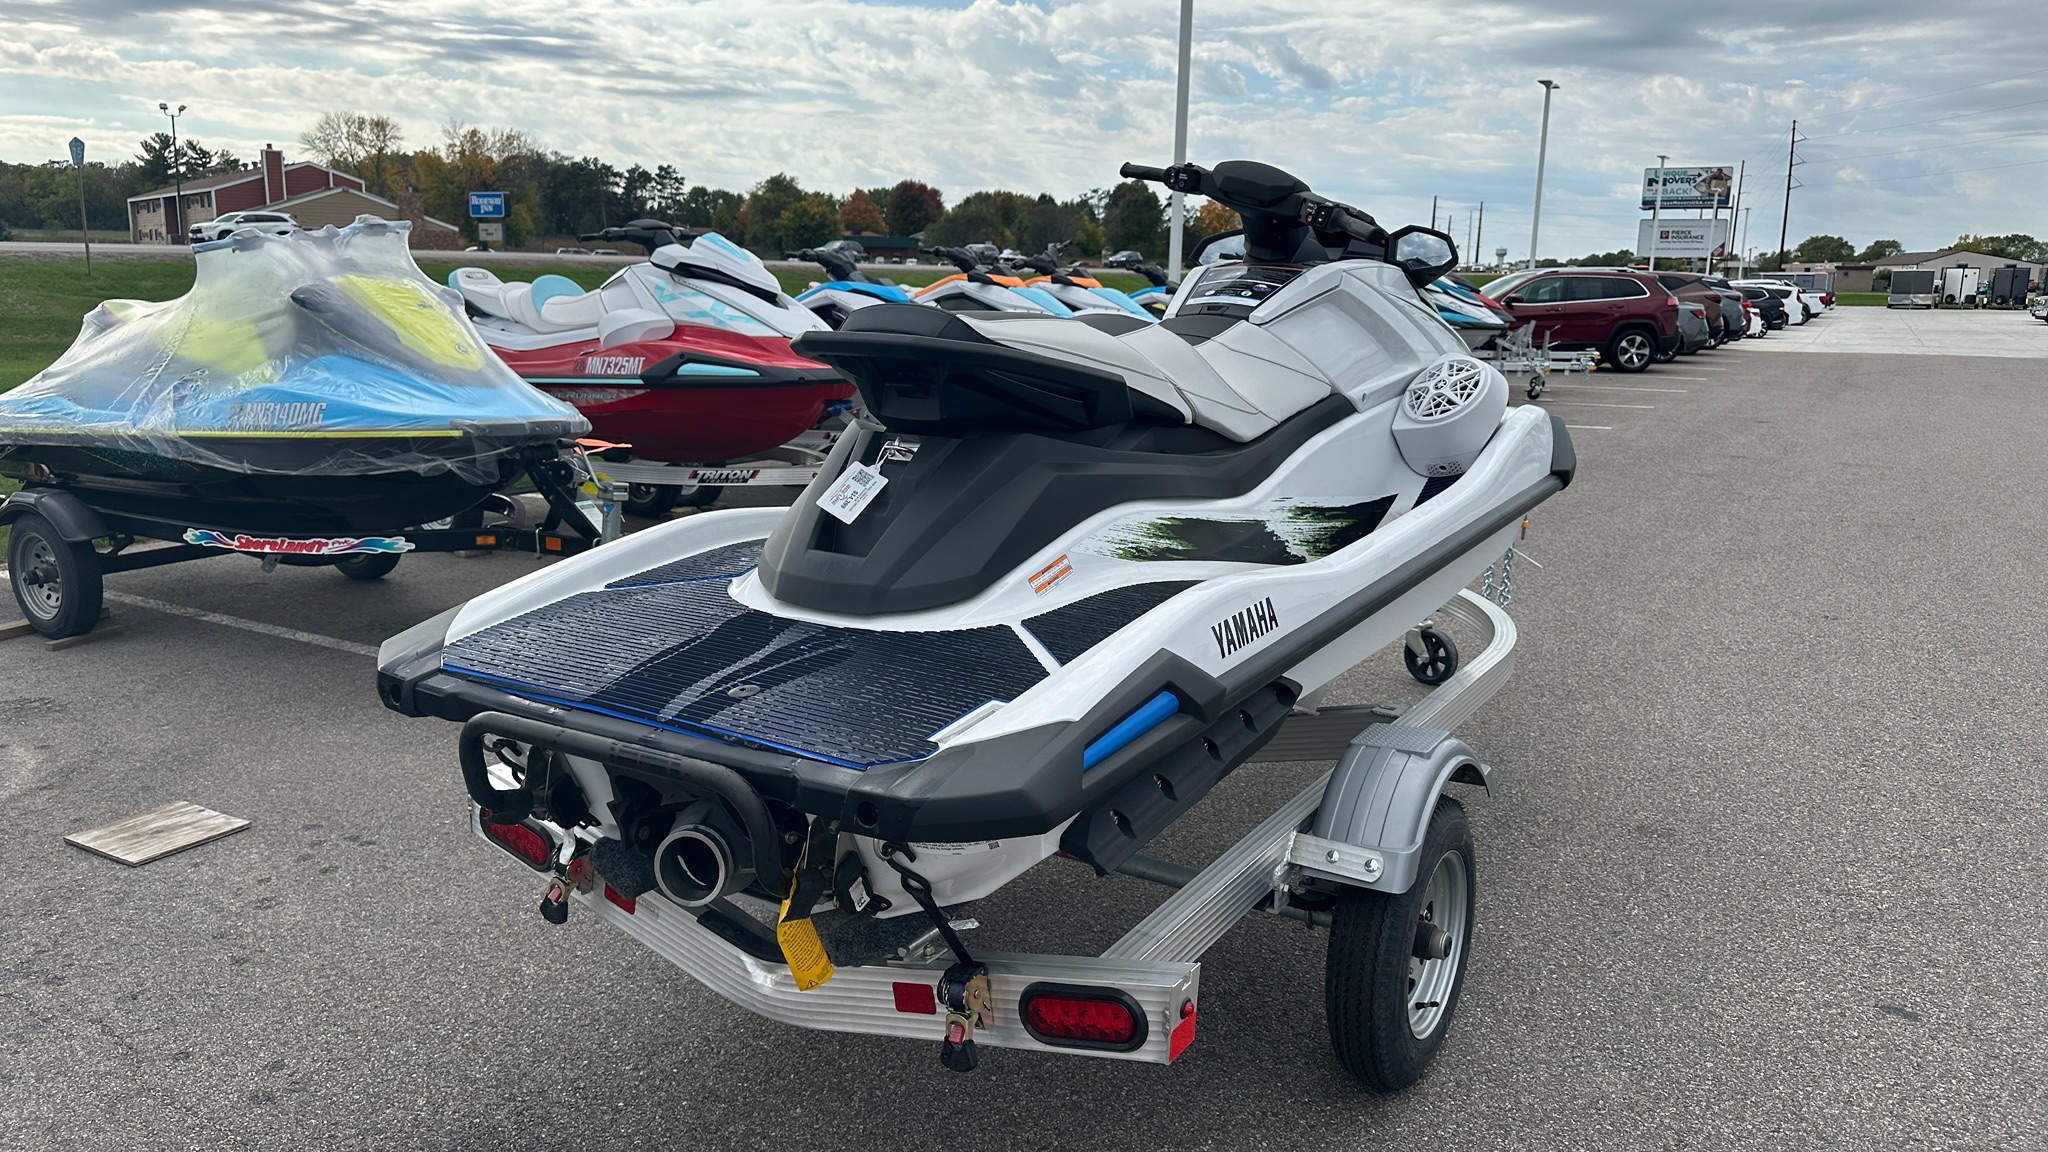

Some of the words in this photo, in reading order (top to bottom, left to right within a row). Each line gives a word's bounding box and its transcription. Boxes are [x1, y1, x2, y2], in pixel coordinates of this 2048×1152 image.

[585, 356, 645, 375] MN7325MT
[696, 470, 753, 479] TRITON
[1211, 596, 1279, 659] YAMAHA
